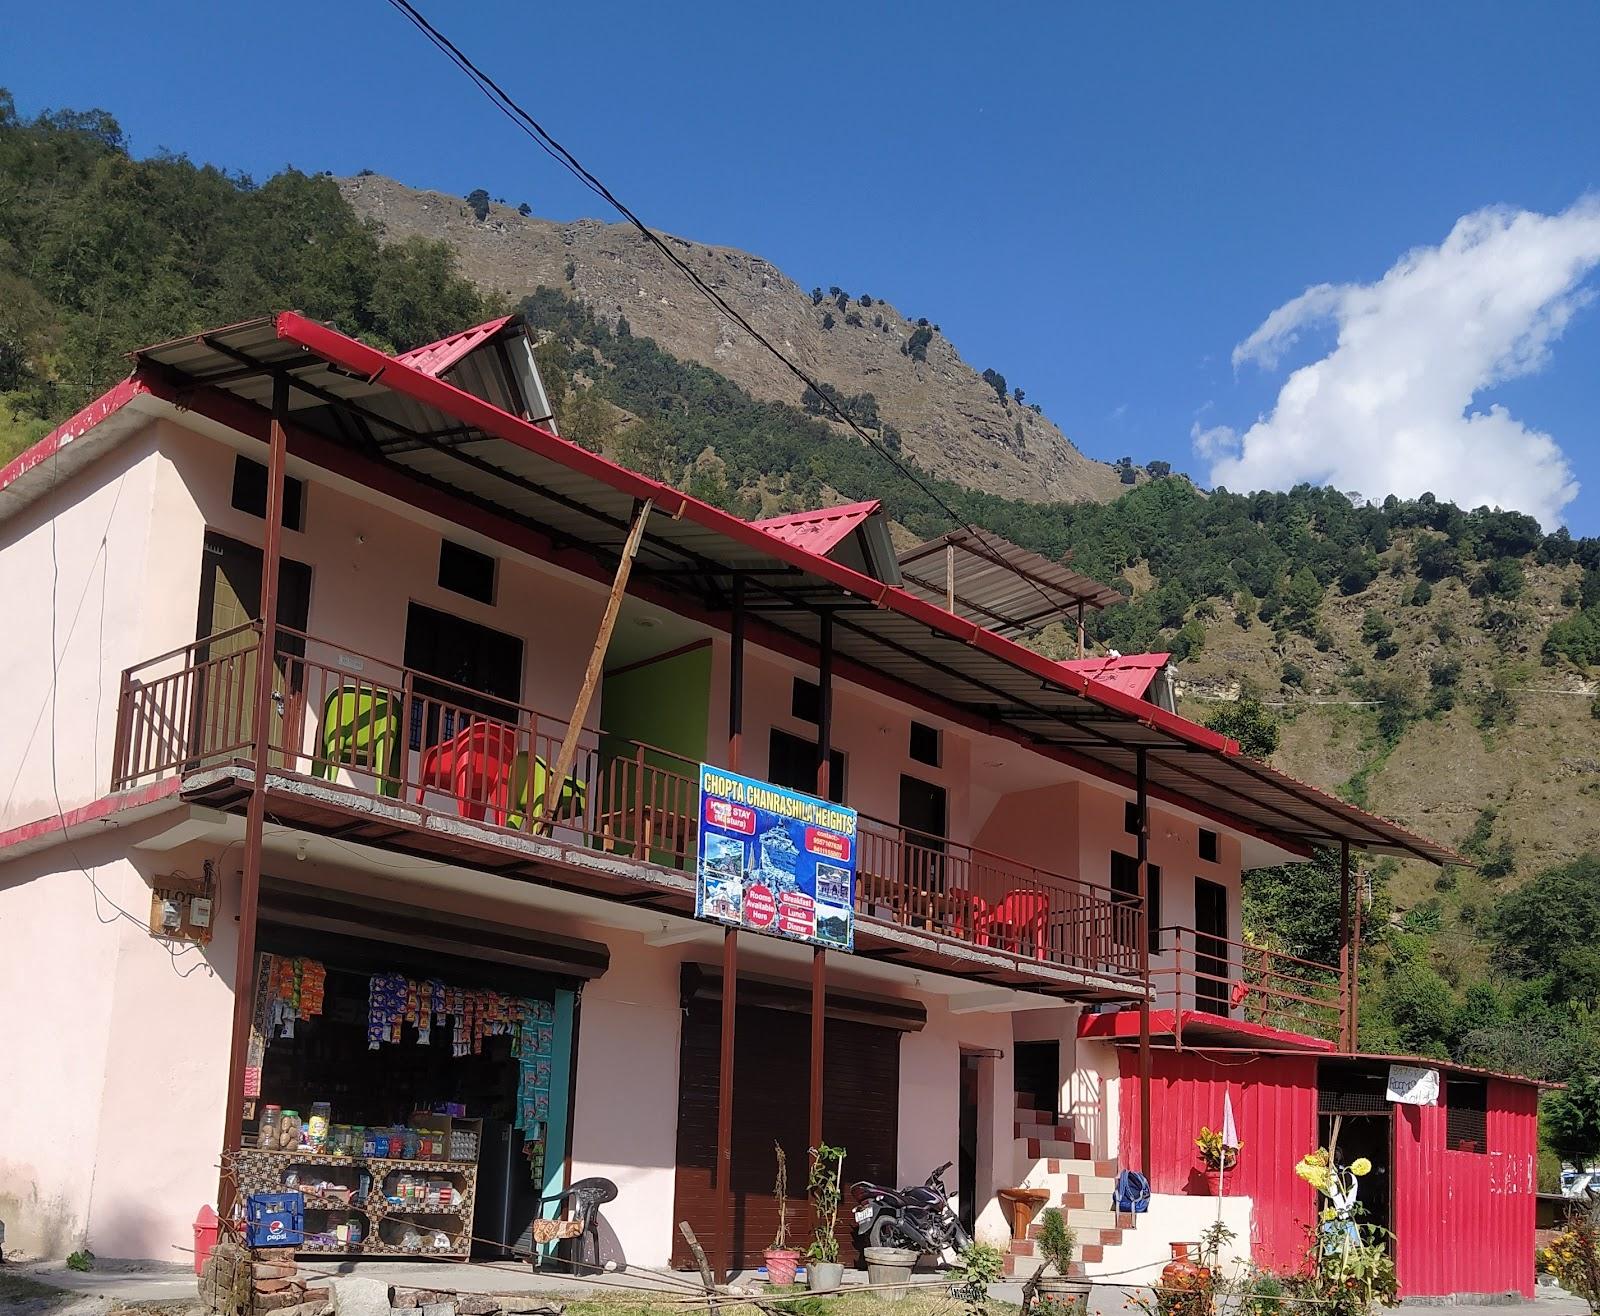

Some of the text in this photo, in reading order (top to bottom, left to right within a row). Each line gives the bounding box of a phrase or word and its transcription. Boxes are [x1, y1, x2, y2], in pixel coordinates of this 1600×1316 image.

[703, 772, 853, 835] CHOPTA CHANRASHILA HEIGHTS
[710, 800, 751, 820] HE STAY
[749, 890, 772, 903] Rooms
[783, 893, 812, 907] Breakfast
[746, 900, 774, 912] Available
[752, 910, 768, 921] Here
[787, 908, 807, 919] Lunch
[786, 921, 807, 933] Dinner
[266, 1233, 287, 1242] pepsi
